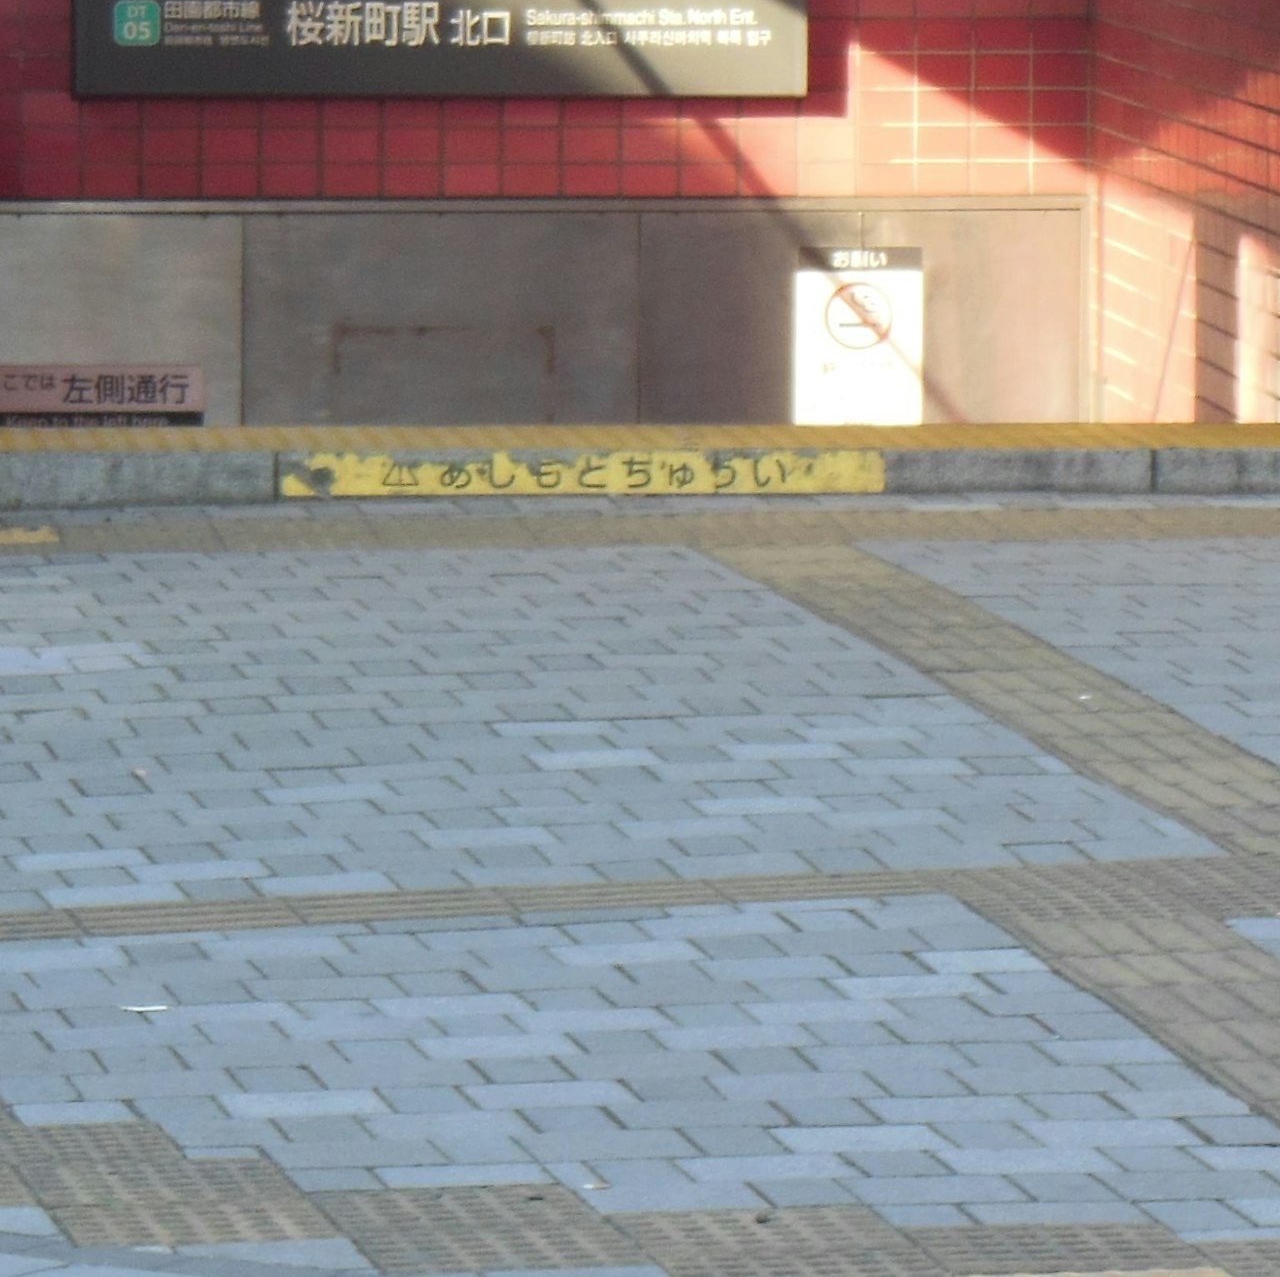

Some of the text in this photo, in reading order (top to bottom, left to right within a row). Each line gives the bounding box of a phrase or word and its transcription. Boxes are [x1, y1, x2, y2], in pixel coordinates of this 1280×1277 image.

[122, 21, 152, 40] 05
[286, 0, 510, 47] 桜新町駅 北口
[62, 373, 191, 406] 左側通行
